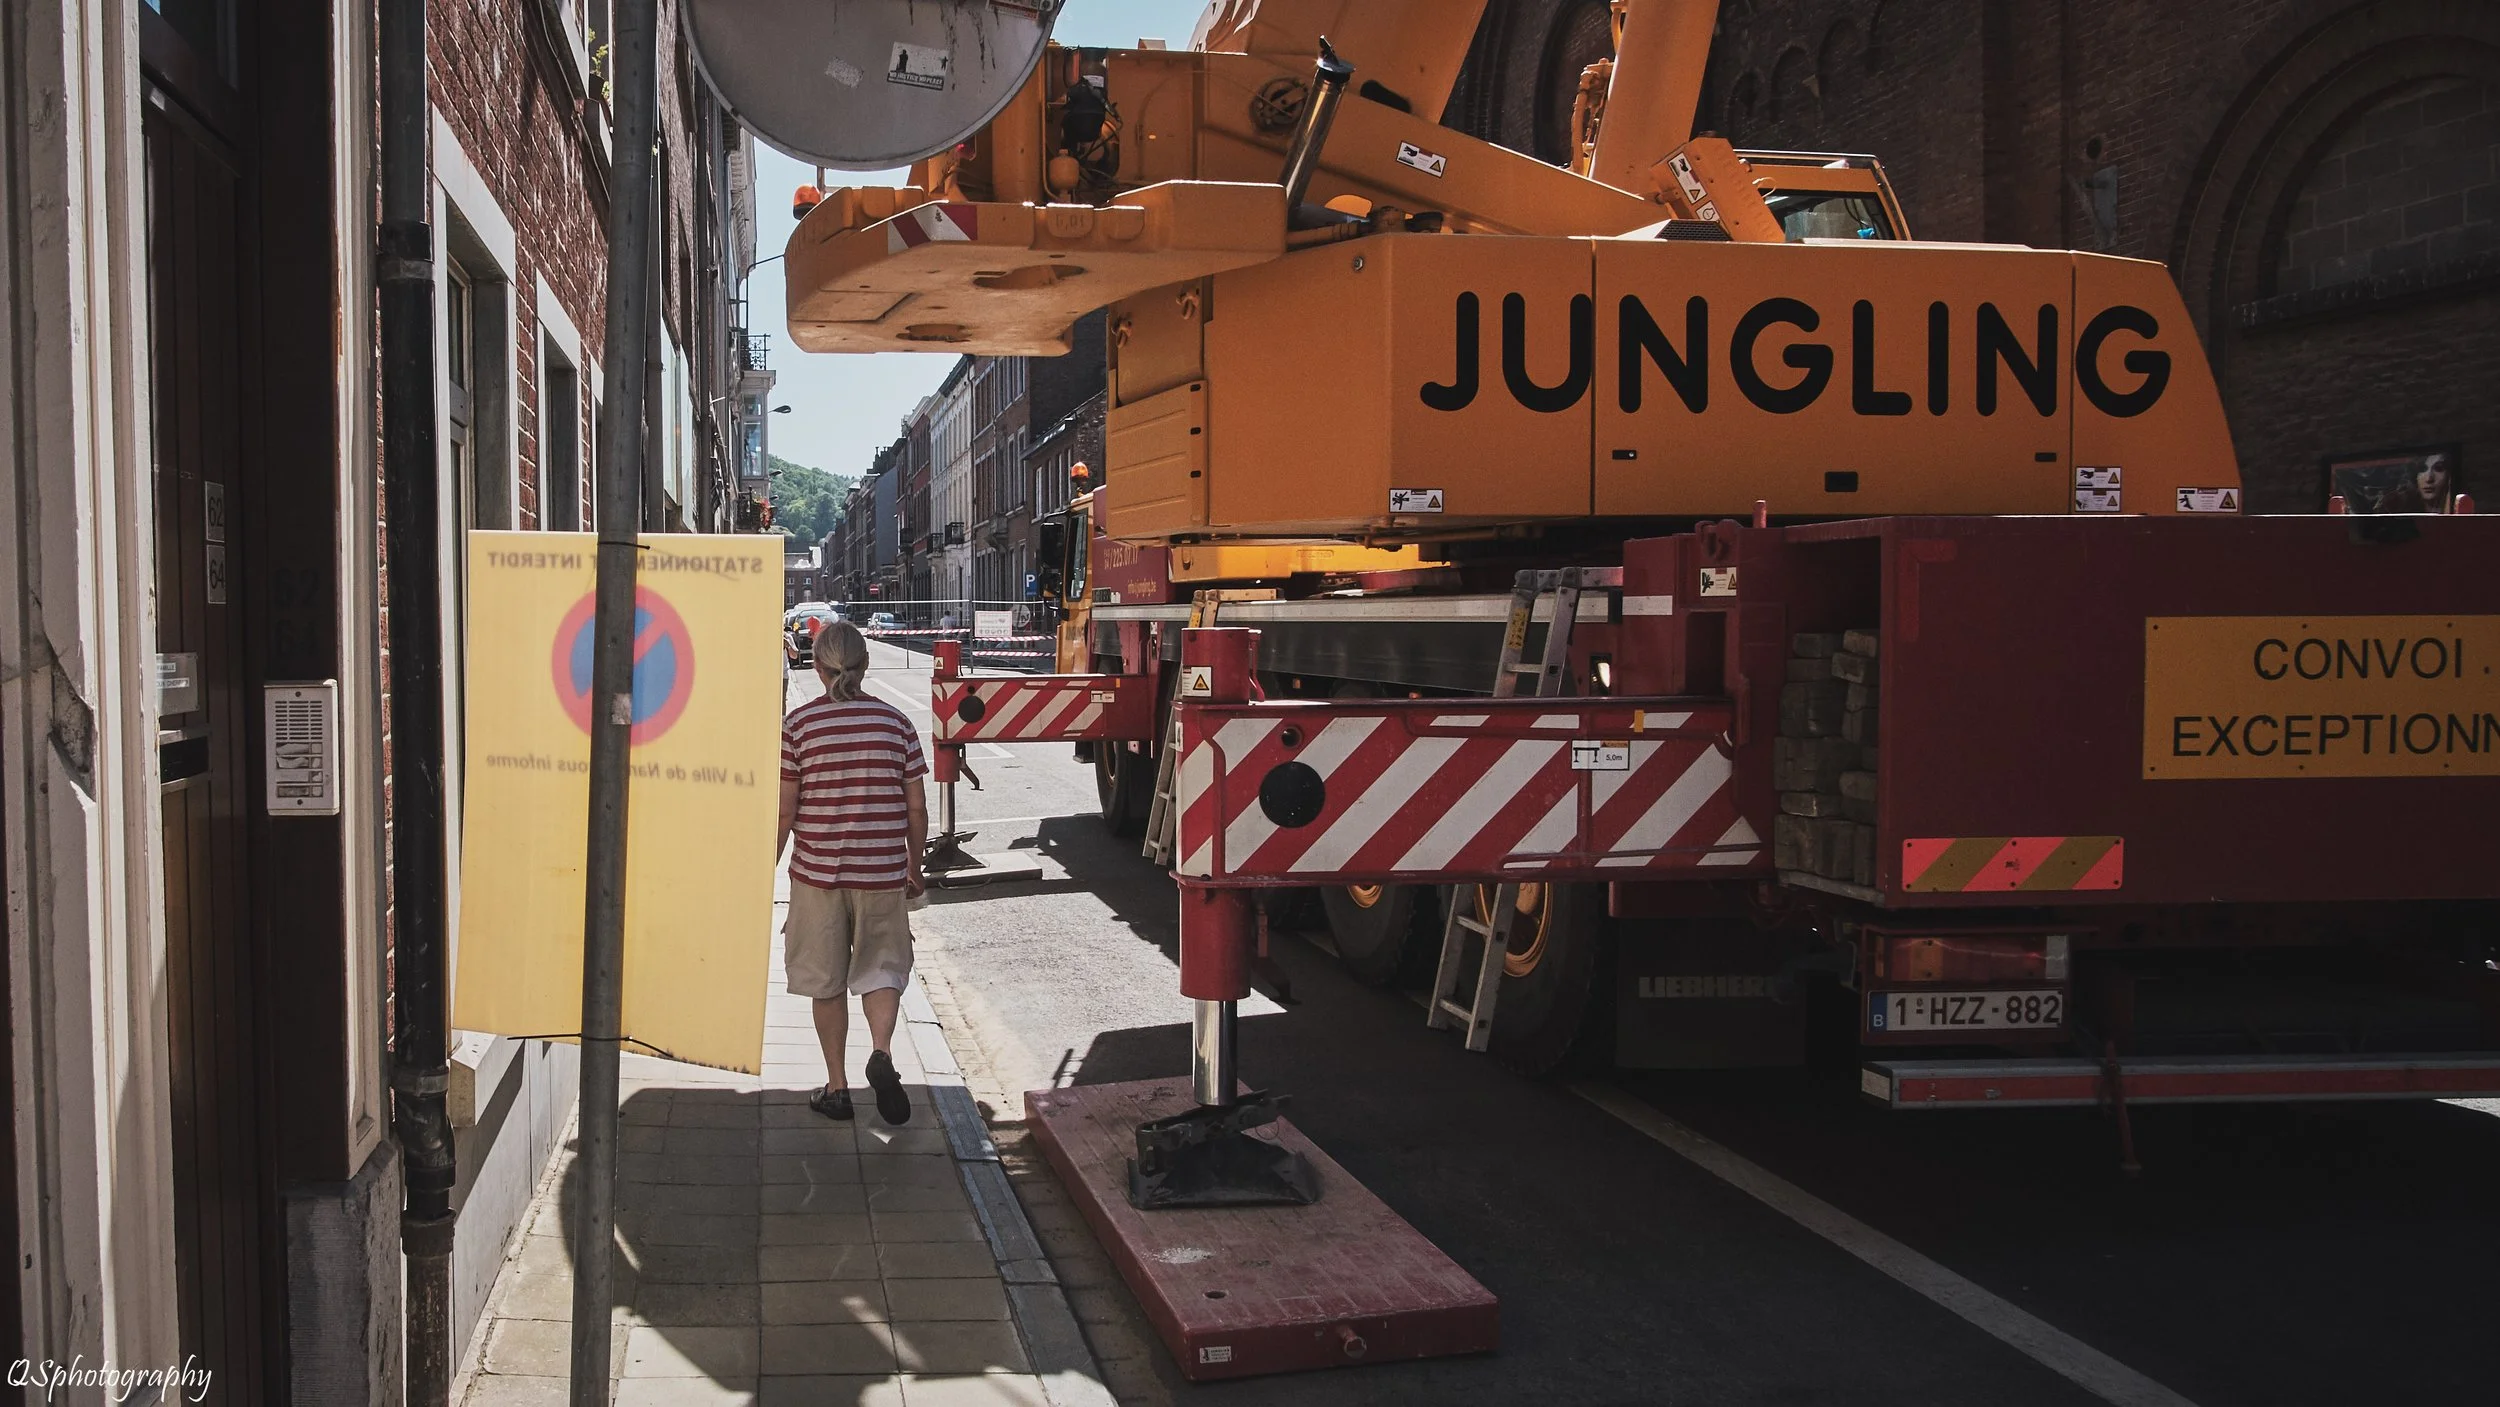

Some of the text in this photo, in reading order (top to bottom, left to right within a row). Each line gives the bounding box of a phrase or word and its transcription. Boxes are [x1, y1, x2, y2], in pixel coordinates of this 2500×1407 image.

[1420, 291, 2171, 418] JUNGLING
[208, 496, 225, 527] 62
[210, 559, 225, 589] 64
[1026, 574, 1035, 588] P
[2253, 637, 2462, 680] CONVOI
[1605, 754, 1623, 762] 5,0m
[1873, 995, 2061, 1027] B 1-HZZ-882
